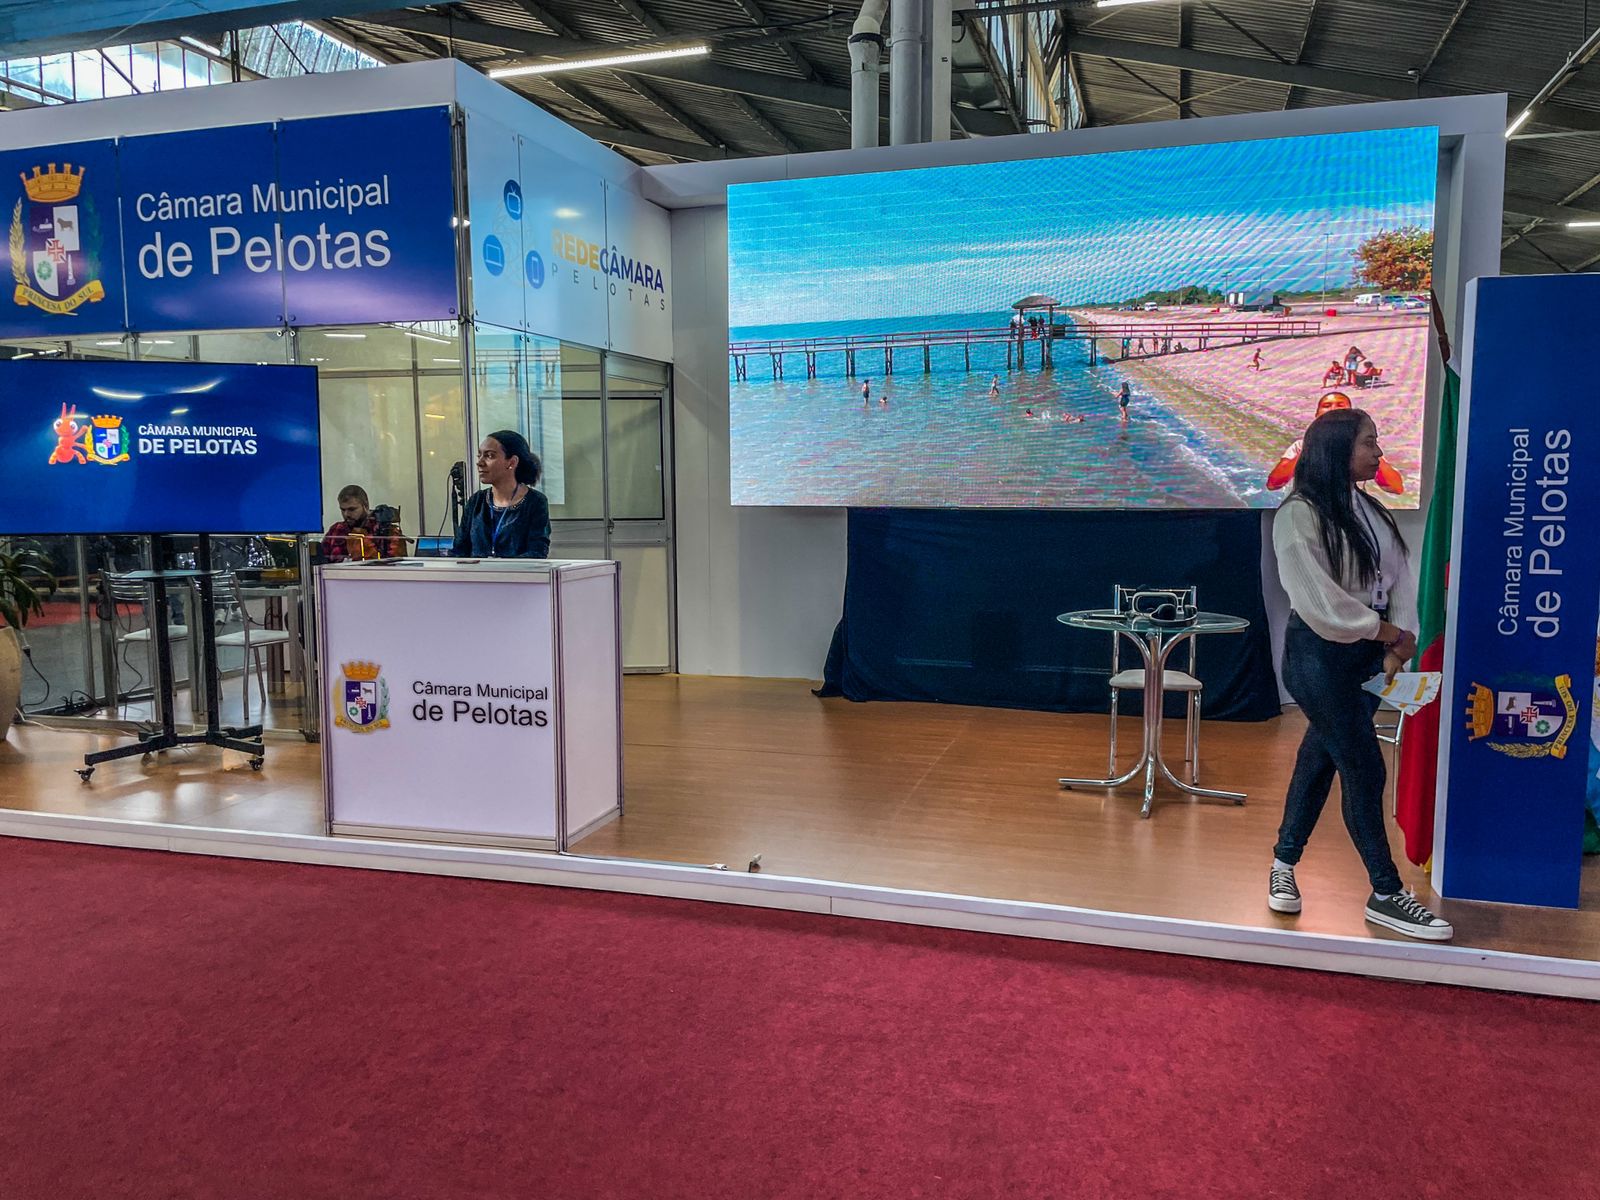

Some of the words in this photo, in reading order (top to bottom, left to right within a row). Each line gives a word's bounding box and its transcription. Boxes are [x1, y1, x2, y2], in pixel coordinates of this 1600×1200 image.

[136, 191, 243, 222] Câmara
[252, 174, 390, 215] Municipal
[138, 231, 193, 279] de
[209, 222, 392, 275] Pelotas
[551, 262, 665, 311] PELOTAS
[138, 423, 190, 437] CÂMARA
[192, 426, 257, 437] MUNICIPAL
[138, 438, 165, 454] DE
[169, 438, 258, 455] PELOTAS
[1503, 427, 1533, 537] Municipal
[1529, 428, 1571, 576] Pelotas
[1497, 545, 1522, 636] Câmara
[1526, 590, 1562, 639] de
[412, 680, 472, 697] Câmara
[476, 683, 548, 702] Municipal
[412, 699, 444, 721] de
[453, 700, 548, 727] Pelotas
